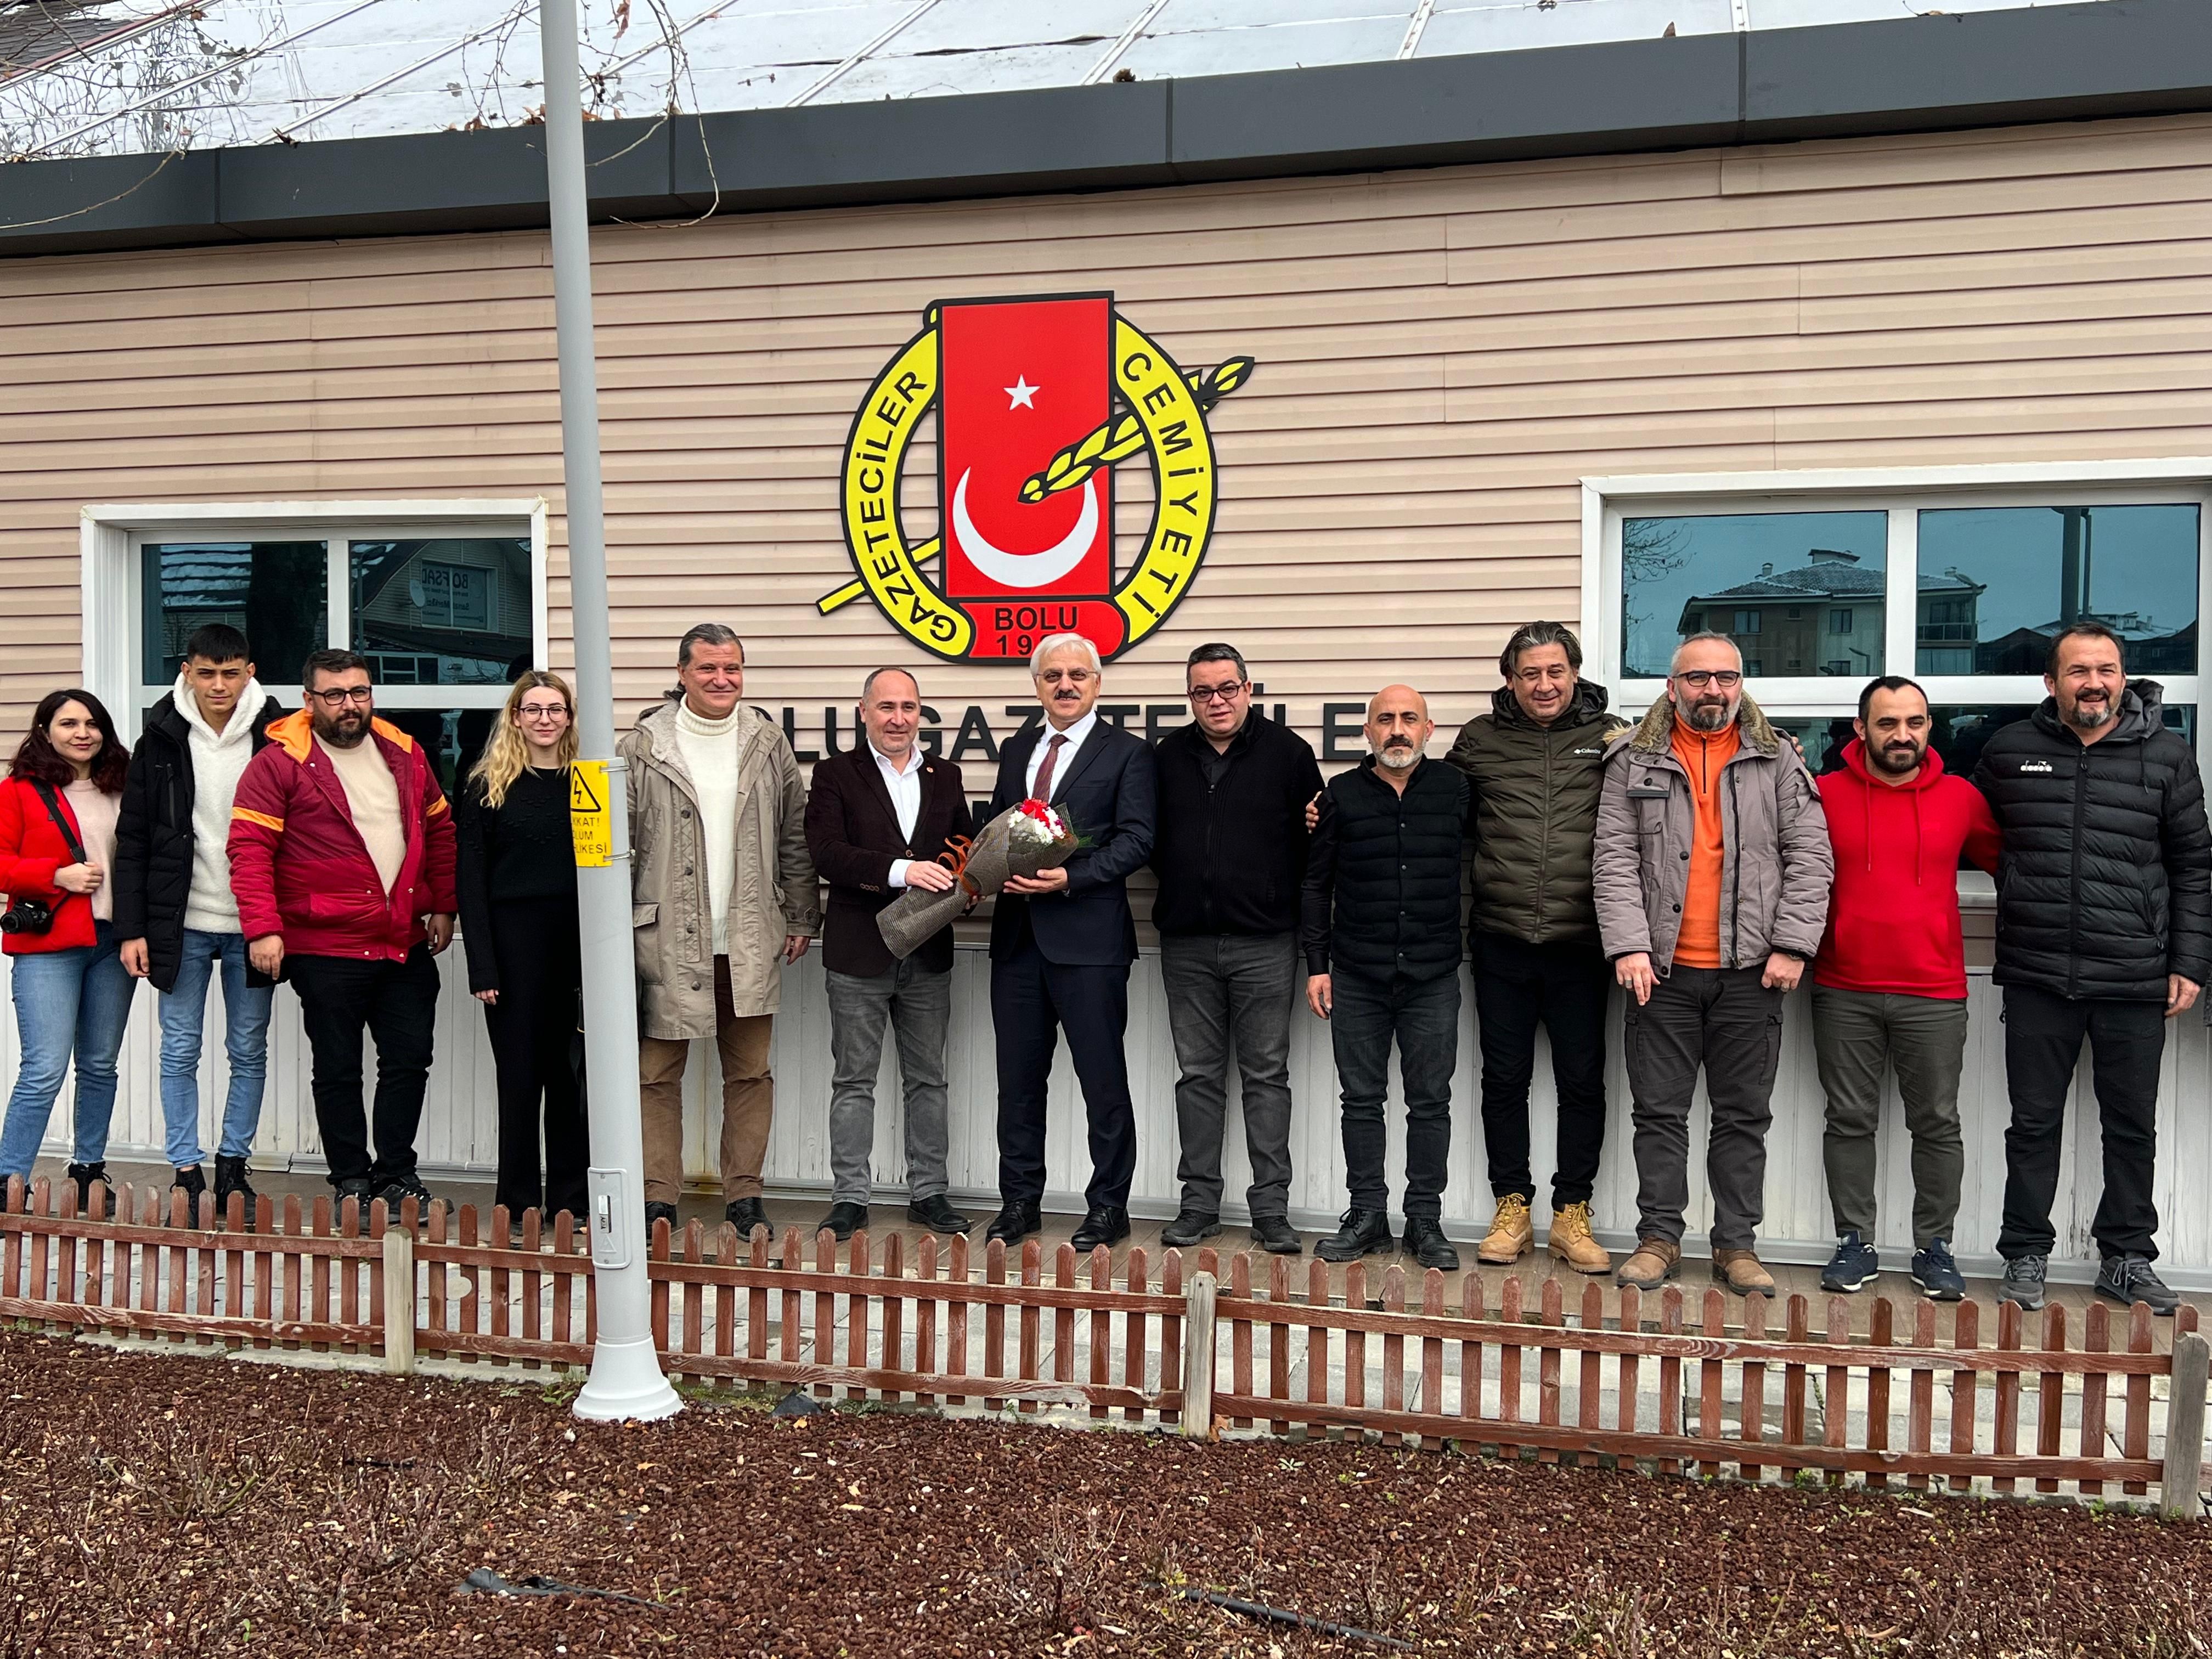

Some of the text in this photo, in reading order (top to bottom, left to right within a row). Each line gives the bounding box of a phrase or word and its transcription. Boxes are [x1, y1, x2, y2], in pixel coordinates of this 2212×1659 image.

[1124, 353, 1204, 618] CEMİYETİ
[856, 371, 957, 641] GAZETECİLER
[995, 606, 1077, 630] BOLU
[996, 634, 1052, 656] 19
[573, 817, 600, 827] KKAT!
